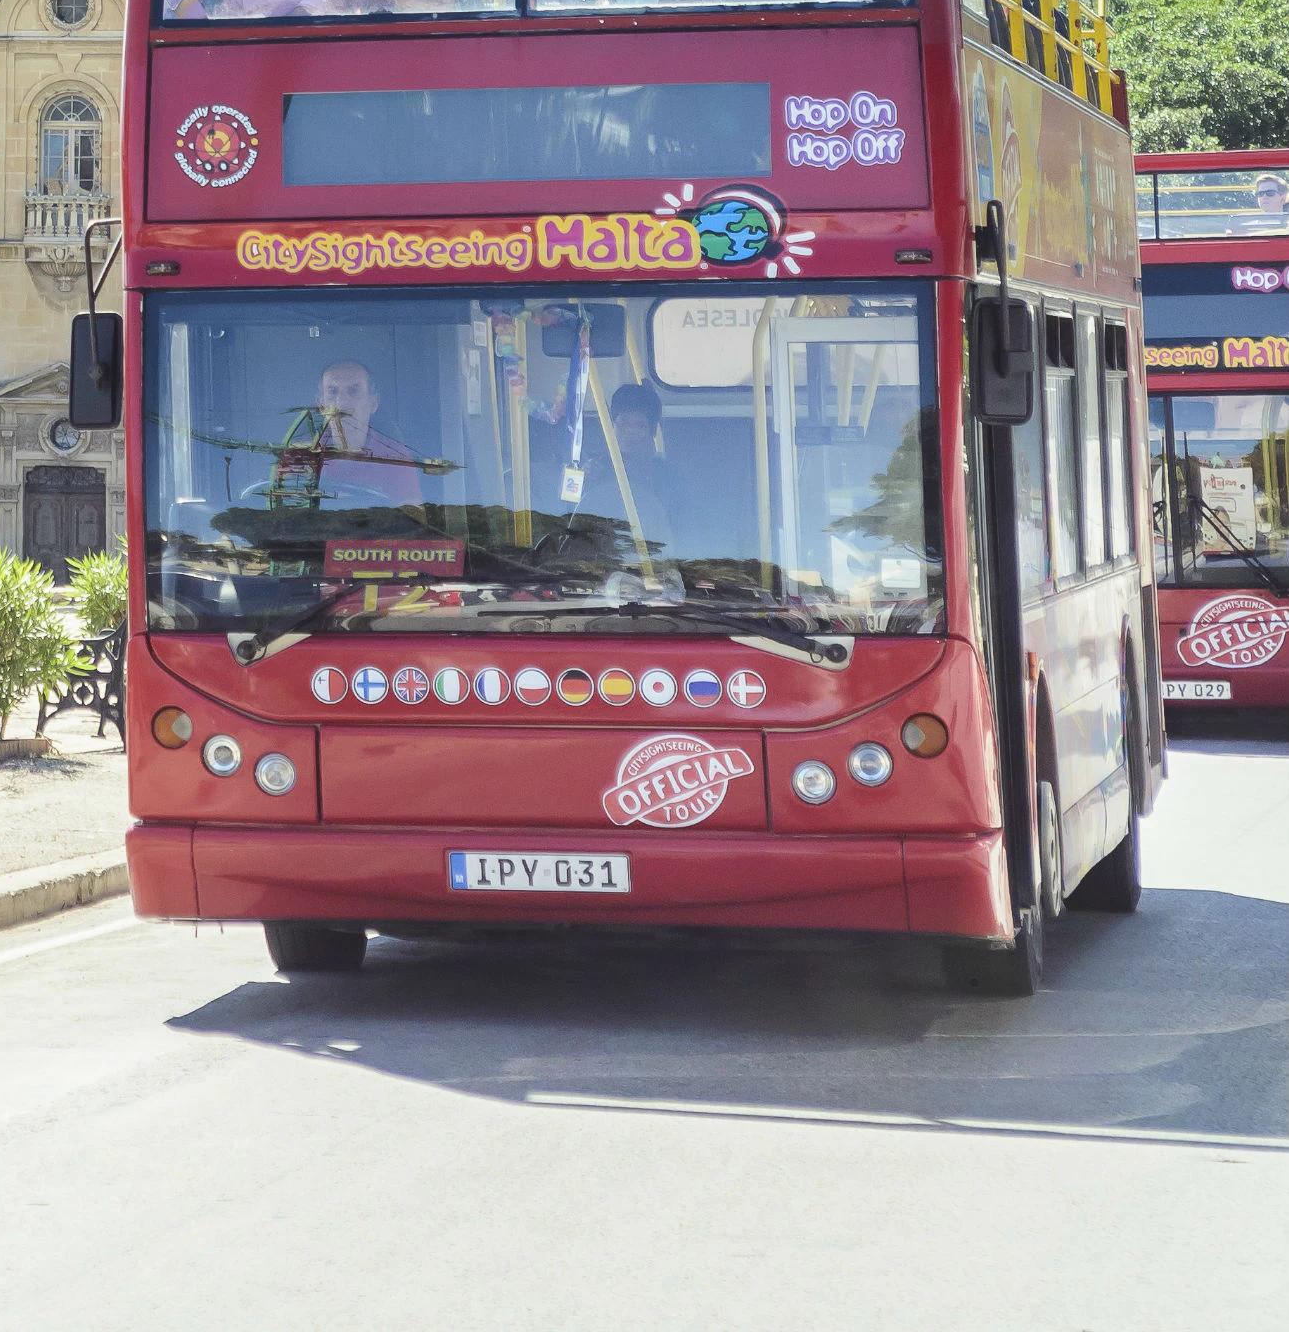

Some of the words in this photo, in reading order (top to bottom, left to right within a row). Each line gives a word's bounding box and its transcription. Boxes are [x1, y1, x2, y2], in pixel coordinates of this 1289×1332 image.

[176, 106, 209, 136] locally
[211, 105, 258, 136] operated
[787, 97, 848, 132] Hop
[852, 92, 896, 127] On
[789, 134, 850, 169] Hop
[853, 130, 903, 164] Off
[174, 151, 210, 187] globally
[211, 148, 258, 187] connected
[238, 231, 530, 271] CitySightseeing
[540, 216, 699, 268] Malta
[1233, 267, 1281, 291] Hop
[332, 548, 392, 562] SOUTH
[397, 549, 457, 562] ROUTE
[1201, 600, 1265, 627] CITYSIGHTSEEING
[1229, 639, 1278, 663] TOUR
[1166, 684, 1187, 697] PY
[1194, 684, 1225, 697] 029
[627, 741, 702, 776] CITYSIGHTSEEING
[618, 753, 744, 815] OFFICIAL
[663, 789, 719, 821] TOUR
[477, 859, 538, 886] IPY
[555, 860, 618, 888] 031
